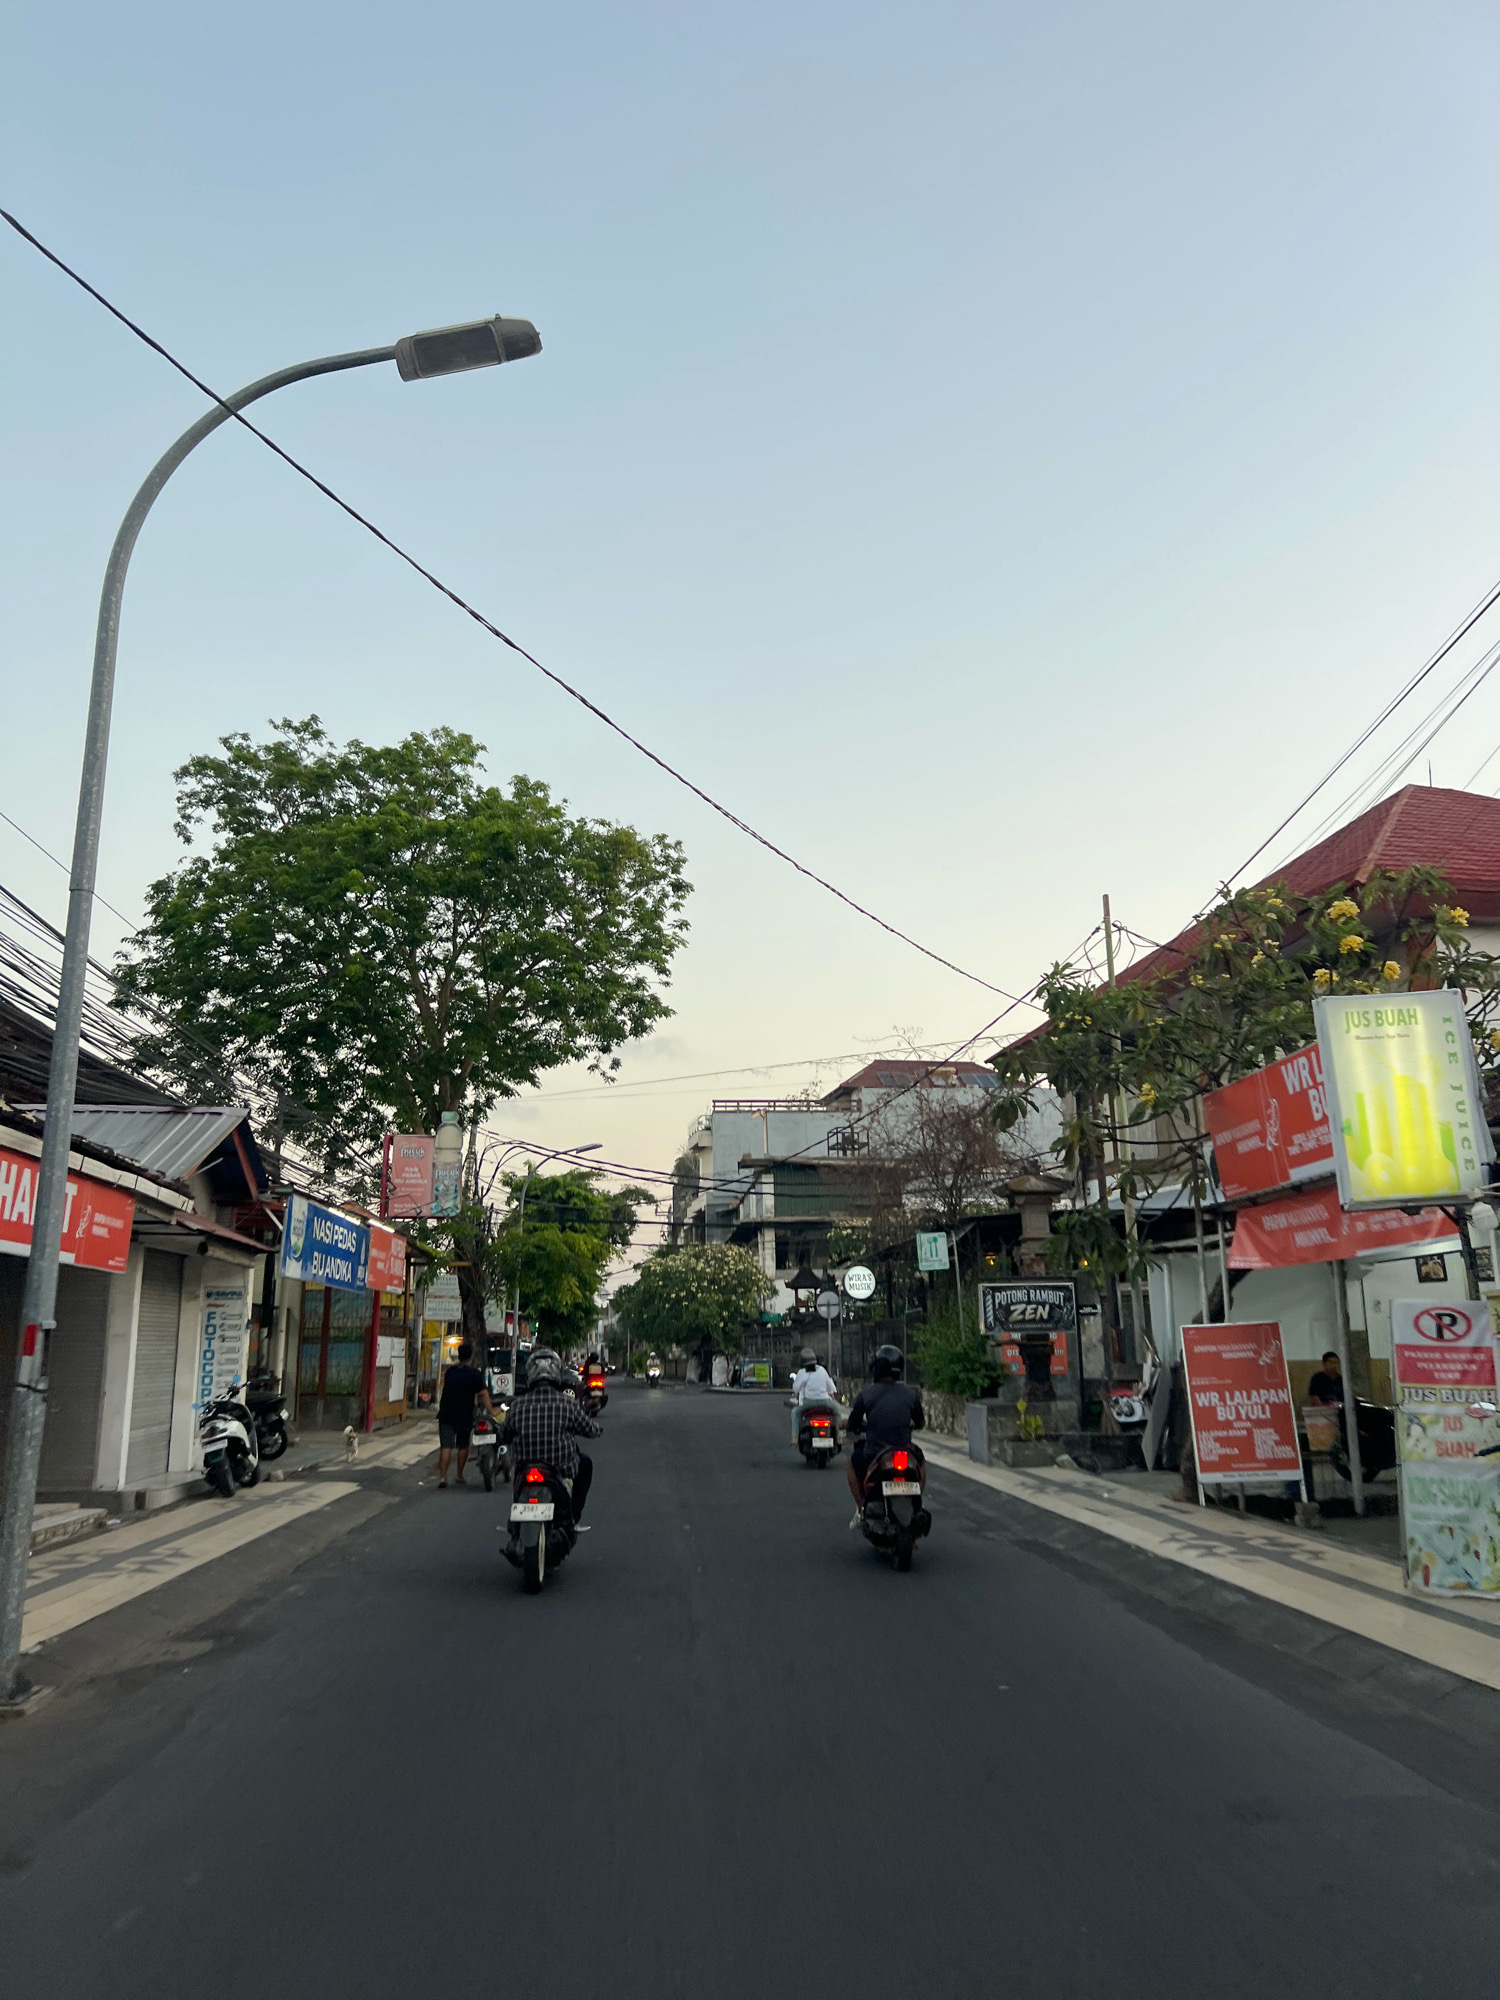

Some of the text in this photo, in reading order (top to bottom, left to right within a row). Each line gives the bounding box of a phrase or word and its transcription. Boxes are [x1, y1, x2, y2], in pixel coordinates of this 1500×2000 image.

[1345, 1008, 1419, 1033] JUS BUAH
[1442, 1016, 1475, 1171] ICE JUICE
[312, 1216, 333, 1246] NASI
[332, 1226, 357, 1253] PEDAS
[311, 1251, 326, 1276] BU
[324, 1256, 352, 1283] ANDIKA
[848, 1282, 872, 1291] MUSIK
[994, 1289, 1065, 1309] POTONG RAMBUT
[1008, 1303, 1050, 1323] ZEN
[199, 1311, 217, 1409] FOTOCOP
[1225, 1388, 1290, 1406] LALAPAN
[1402, 1387, 1497, 1404] JUS BUAH
[1216, 1404, 1271, 1421] BU YULI
[1442, 1415, 1465, 1433] JUS
[1434, 1439, 1477, 1459] BUAH
